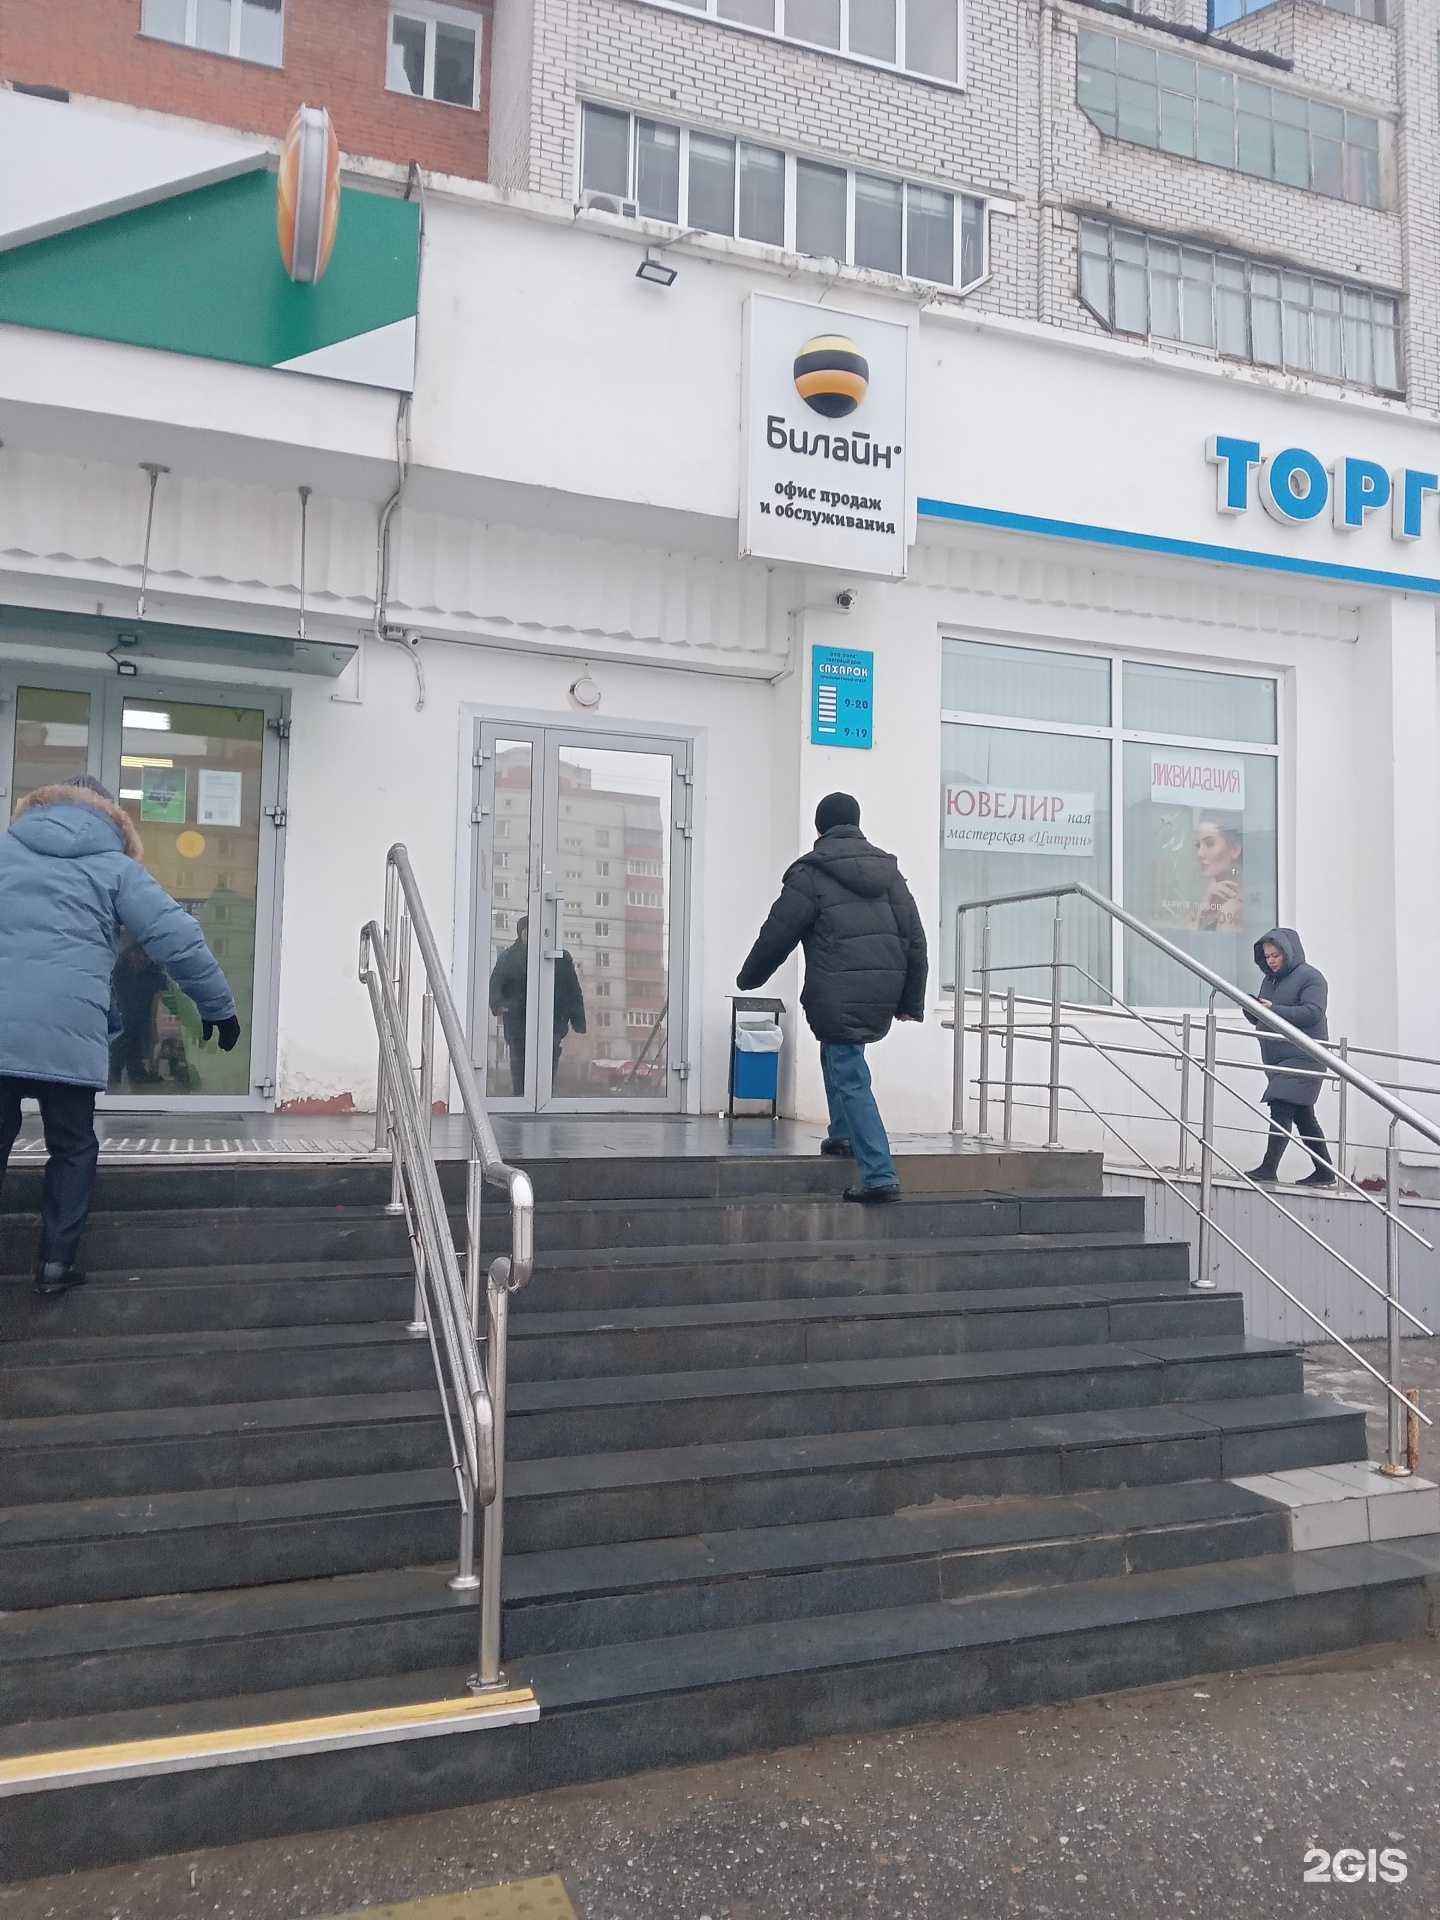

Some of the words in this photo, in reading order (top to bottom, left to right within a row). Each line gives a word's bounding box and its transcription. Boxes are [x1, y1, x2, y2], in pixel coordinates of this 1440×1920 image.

[766, 414, 891, 469] Билайн
[774, 481, 816, 500] офис
[820, 490, 882, 511] продаж
[1207, 435, 1440, 540] ТОРГ
[760, 501, 771, 515] и
[775, 502, 896, 534] обслуживания
[819, 663, 868, 678] САХАРОК
[844, 698, 869, 710] 9-20
[946, 789, 1065, 822] ЮВЕЛИР
[1067, 813, 1091, 824] ная
[946, 828, 1025, 846] мастерская
